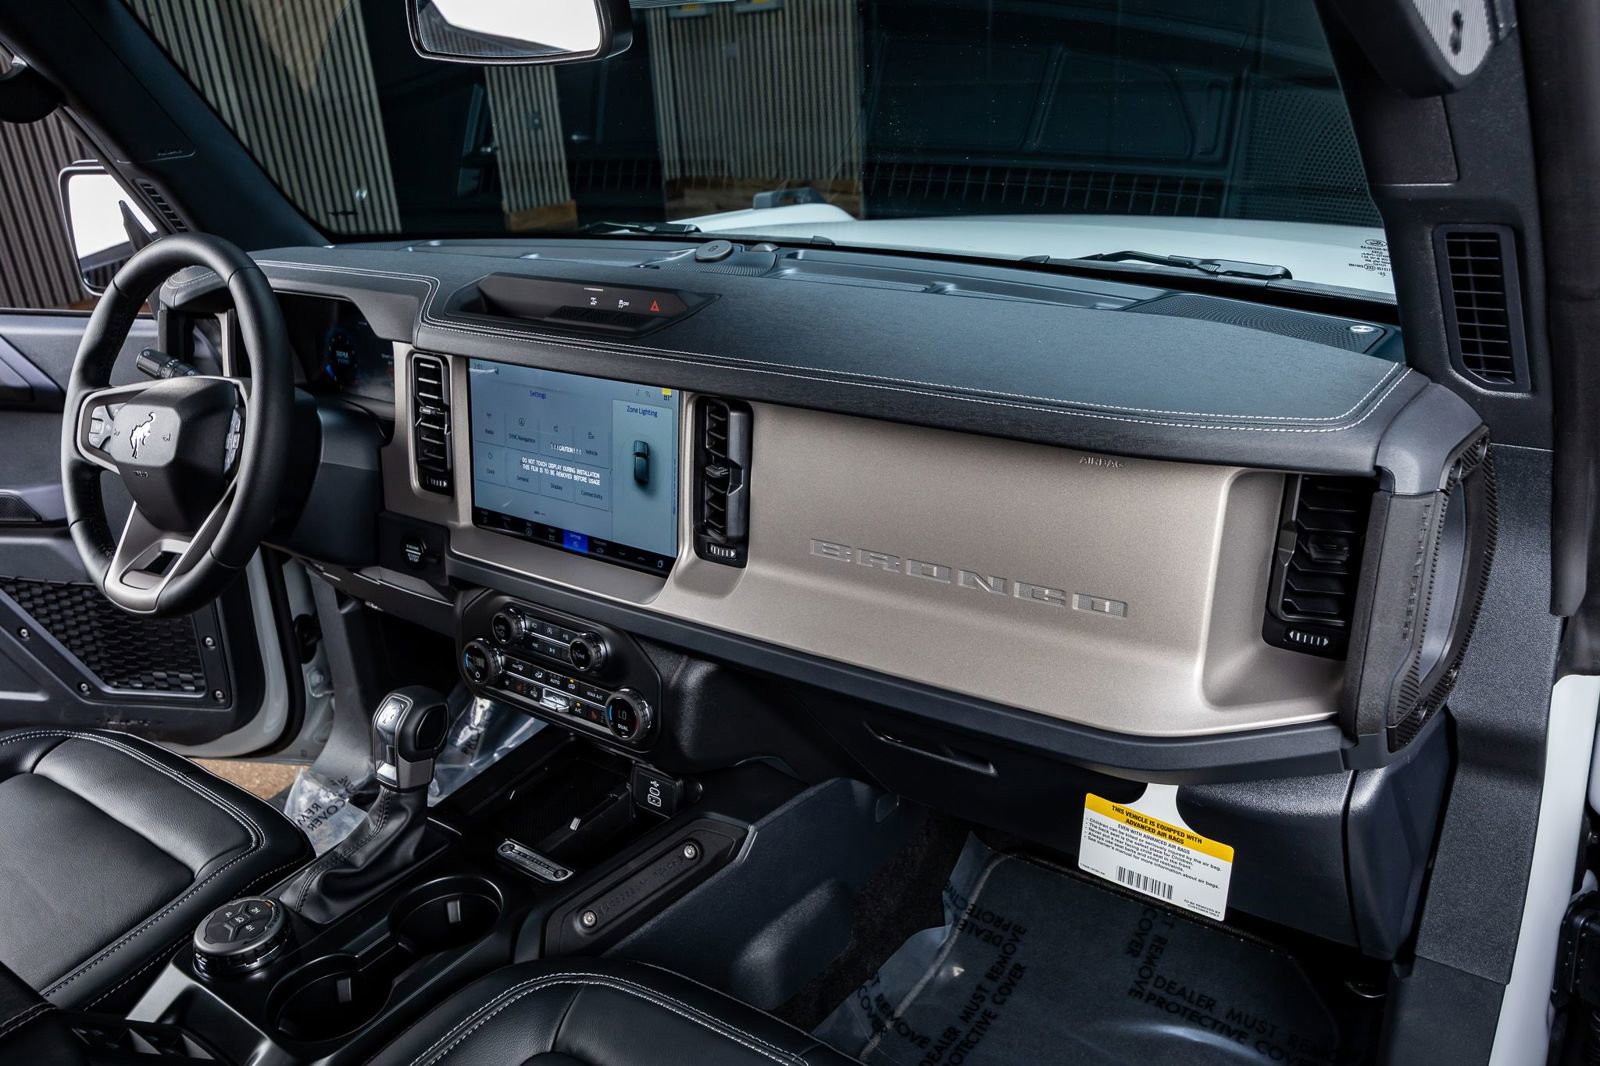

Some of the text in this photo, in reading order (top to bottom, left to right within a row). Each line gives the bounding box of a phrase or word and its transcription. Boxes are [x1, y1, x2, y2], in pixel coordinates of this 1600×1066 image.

[626, 405, 658, 418] Zone Lighting
[548, 462, 562, 470] DISPLAY
[563, 466, 576, 474] DURING
[577, 468, 600, 479] INSTALLATION
[556, 470, 572, 480] REMOVED
[573, 474, 587, 483] BEFORE
[588, 478, 600, 486] USAGE
[1080, 455, 1124, 471] AIRBAG
[810, 538, 1128, 619] BRONCO
[618, 723, 629, 731] DUAL
[1088, 831, 1104, 841] Always
[1088, 826, 1101, 835] Never
[1124, 842, 1139, 851] facing
[1089, 817, 1108, 828] Children
[1125, 832, 1138, 840] killed
[1144, 840, 1166, 851] seriously
[1167, 848, 1185, 858] injured
[1111, 805, 1124, 814] THIS
[1125, 810, 1148, 824] VEHICLE
[1156, 822, 1185, 838] EQUIPPED
[1186, 833, 1202, 844] WITH
[1117, 823, 1129, 831] EVEN
[1130, 828, 1142, 836] WITH
[1143, 833, 1167, 846] ADVANCED
[1177, 845, 1190, 854] BAGS
[1125, 817, 1184, 844] ADVANCED AIR BAGS
[1115, 847, 1132, 856] manual
[1153, 861, 1181, 875] information
[1182, 872, 1197, 881] about
[1134, 841, 1148, 849] safest
[1149, 846, 1162, 854] place
[1125, 907, 1158, 958] COVER
[960, 984, 990, 1024] MUST
[985, 924, 1027, 983] REMOVE
[1128, 934, 1168, 1000] REMOVE
[992, 963, 1027, 1006] COVER
[874, 994, 931, 1050] REMOVE
[1145, 992, 1248, 1044] PROTECTIVE
[1152, 974, 1217, 1013] DEALER
[1225, 1007, 1280, 1038] MUST
